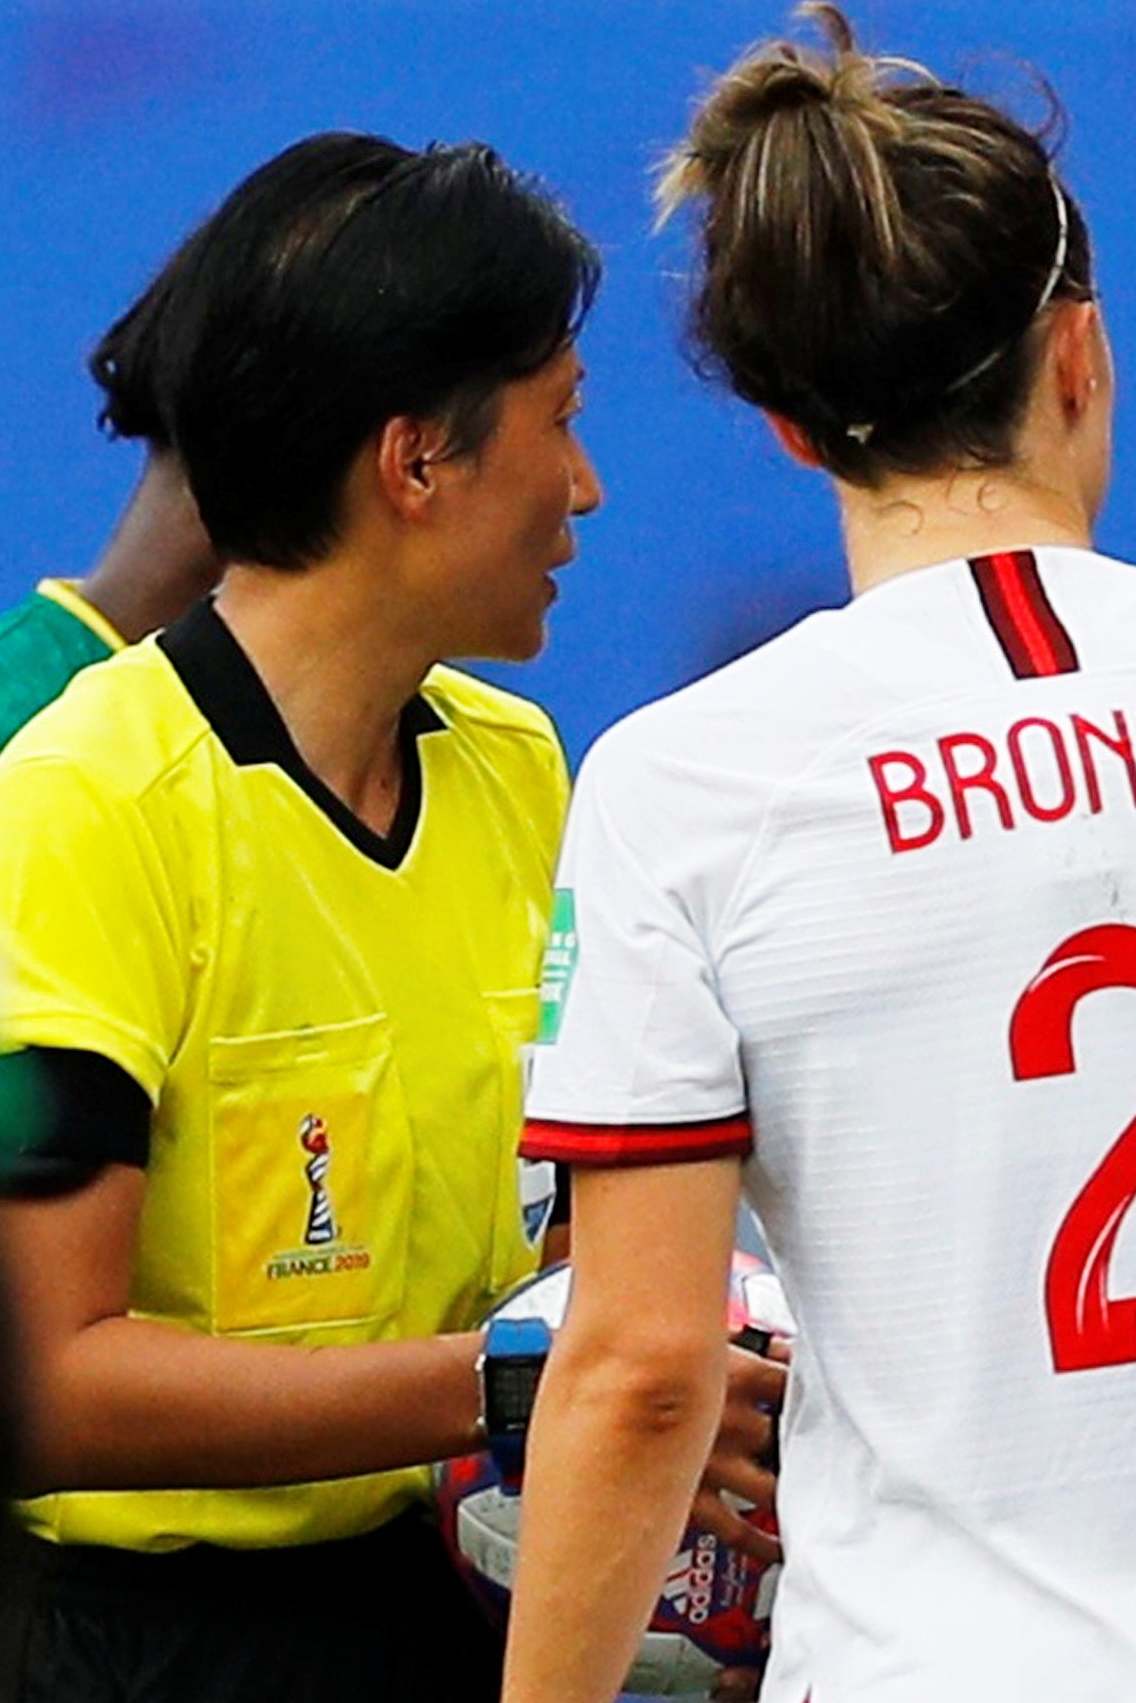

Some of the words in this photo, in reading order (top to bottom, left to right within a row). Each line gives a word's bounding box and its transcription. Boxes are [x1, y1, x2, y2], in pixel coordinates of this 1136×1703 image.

[267, 1257, 332, 1280] FRANCE
[333, 1252, 370, 1273] 2019
[689, 1534, 717, 1624] adidas
